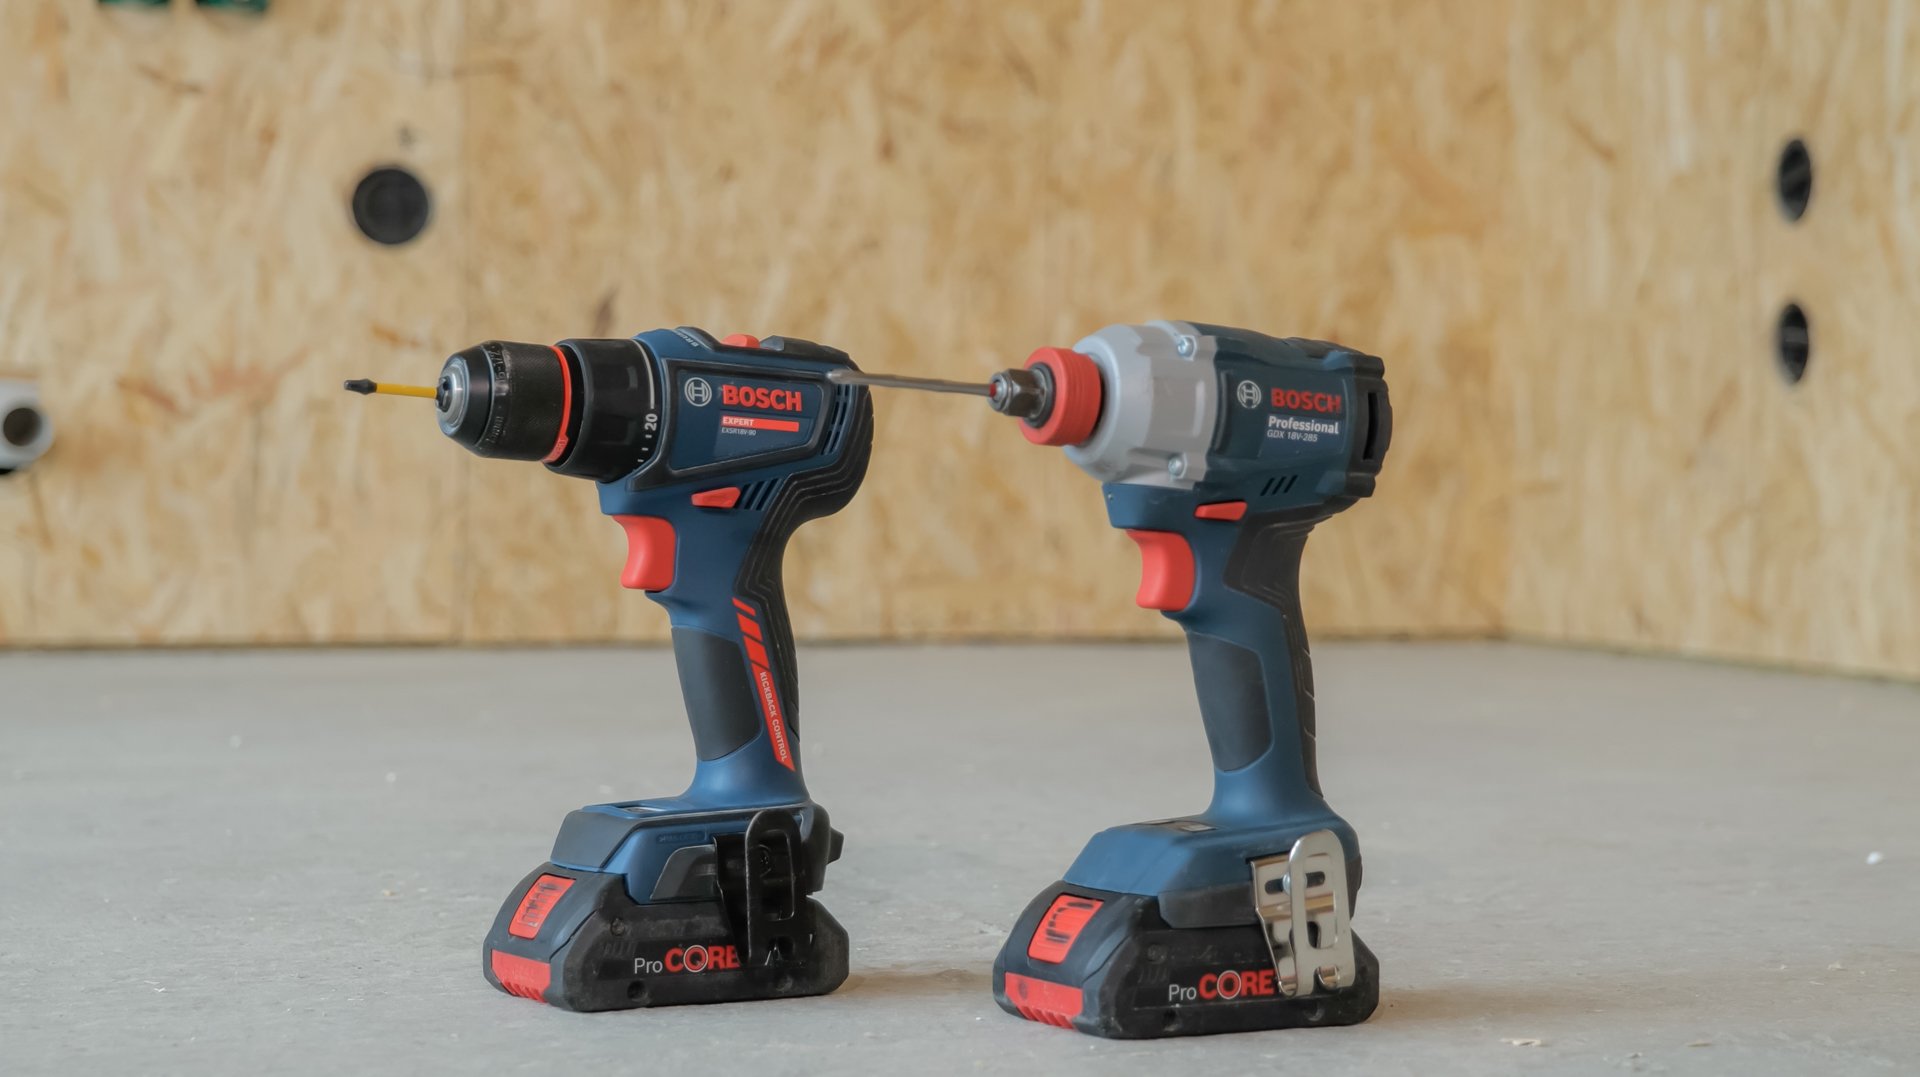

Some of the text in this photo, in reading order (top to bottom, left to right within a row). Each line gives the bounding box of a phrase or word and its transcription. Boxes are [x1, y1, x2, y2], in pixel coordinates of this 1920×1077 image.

[722, 384, 803, 412] BOSCH
[1271, 388, 1341, 413] BOSCH
[644, 413, 658, 431] 20
[722, 415, 755, 427] EXPERT
[1268, 415, 1339, 435] Professional
[1267, 429, 1318, 442] GDX 18V-285
[759, 671, 787, 762] KICKBACK CONTROL
[634, 957, 664, 974] Pro
[1169, 984, 1197, 1001] Pro
